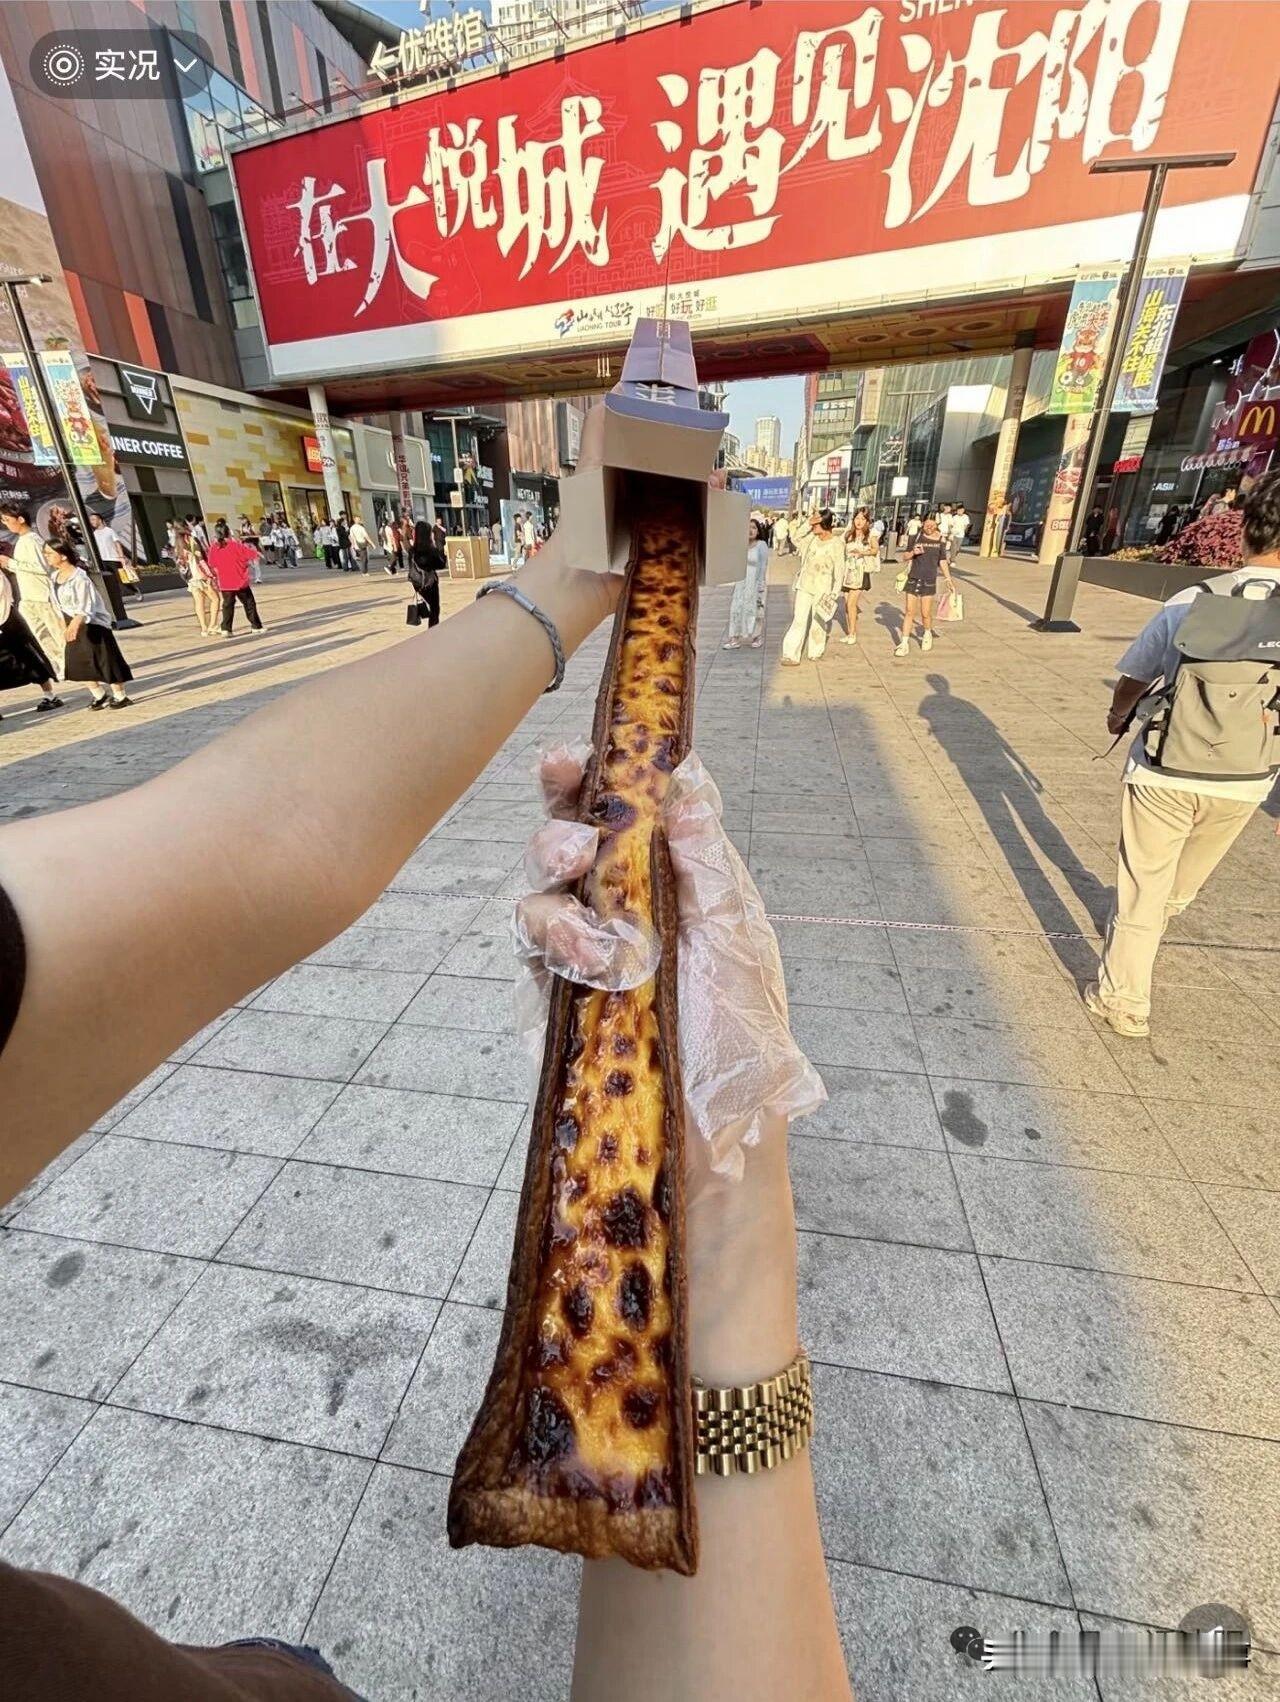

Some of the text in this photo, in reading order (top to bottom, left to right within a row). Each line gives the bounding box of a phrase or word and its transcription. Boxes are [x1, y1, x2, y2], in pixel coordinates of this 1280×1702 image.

[285, 0, 1190, 318] 在大悦城 遇见沈阳
[671, 300, 693, 315] 好玩
[605, 320, 622, 330] TOUR
[142, 440, 184, 459] COFFEE
